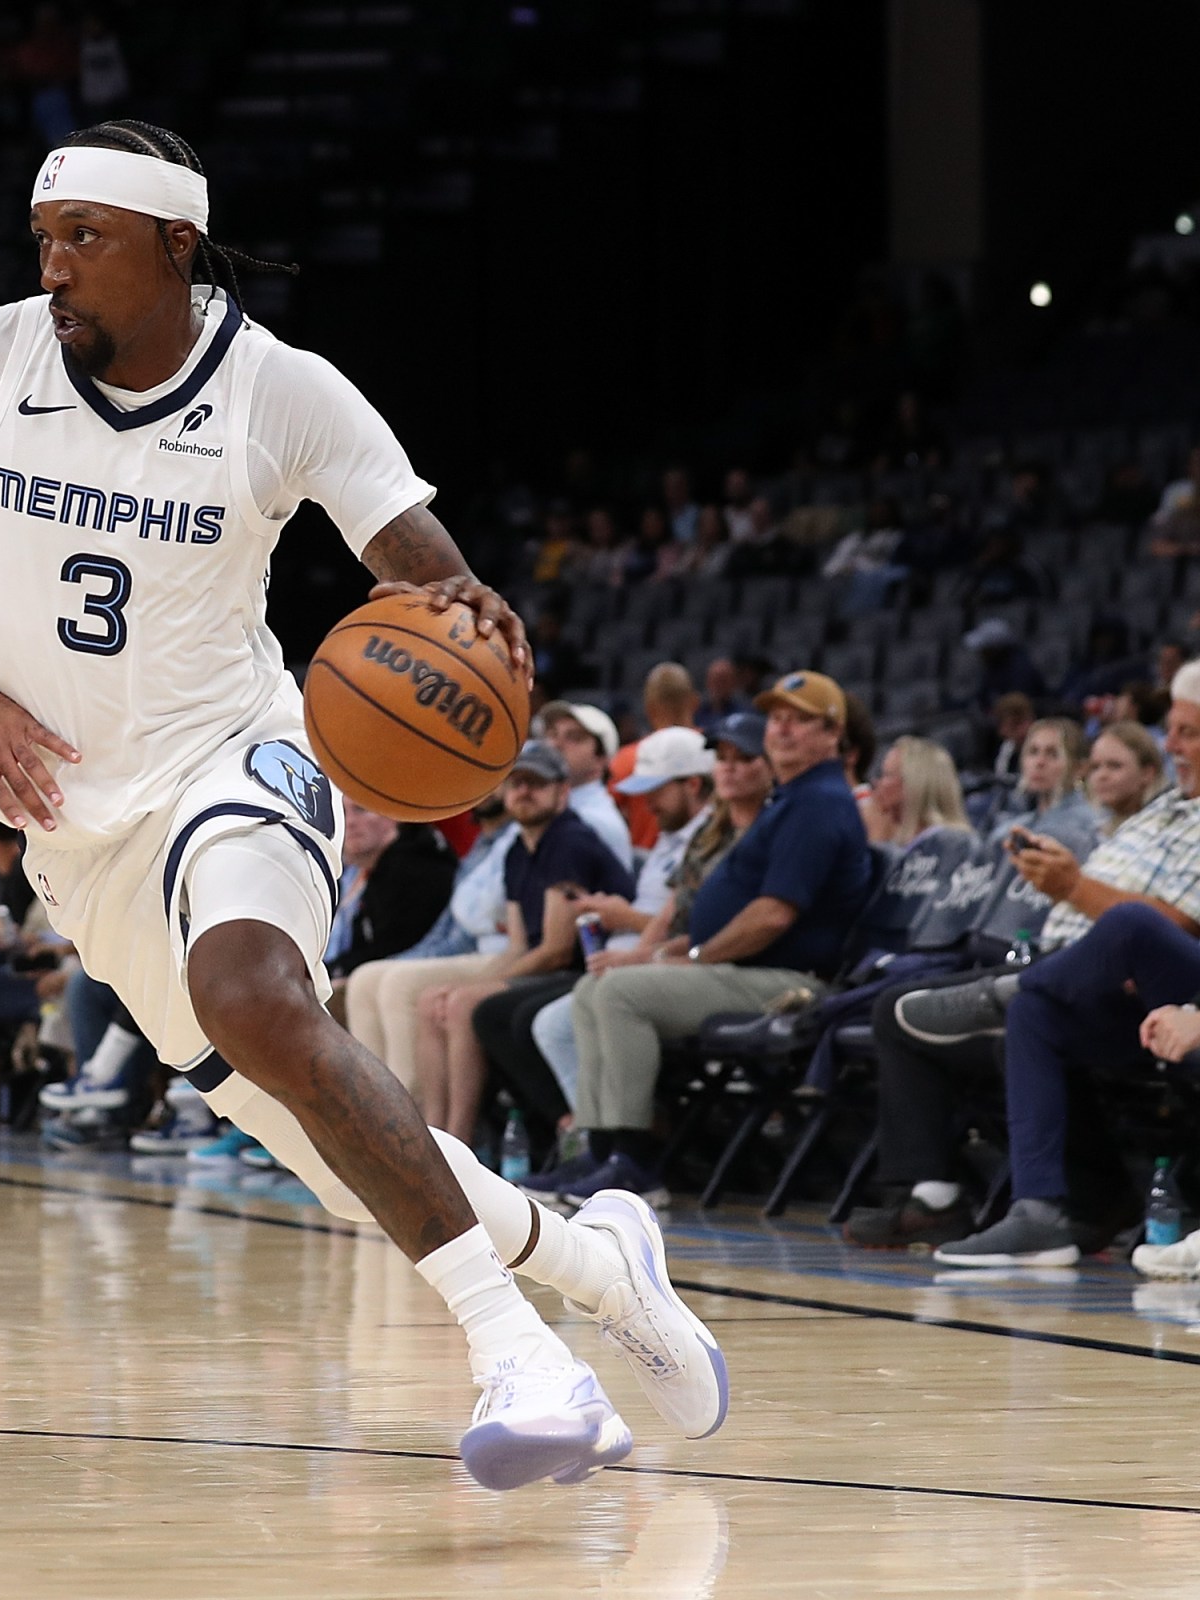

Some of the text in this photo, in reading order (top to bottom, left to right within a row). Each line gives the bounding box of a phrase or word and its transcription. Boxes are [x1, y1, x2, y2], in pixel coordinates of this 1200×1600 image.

[158, 438, 223, 458] Robinhood
[56, 552, 133, 657] 3
[364, 635, 494, 747] Wilson
